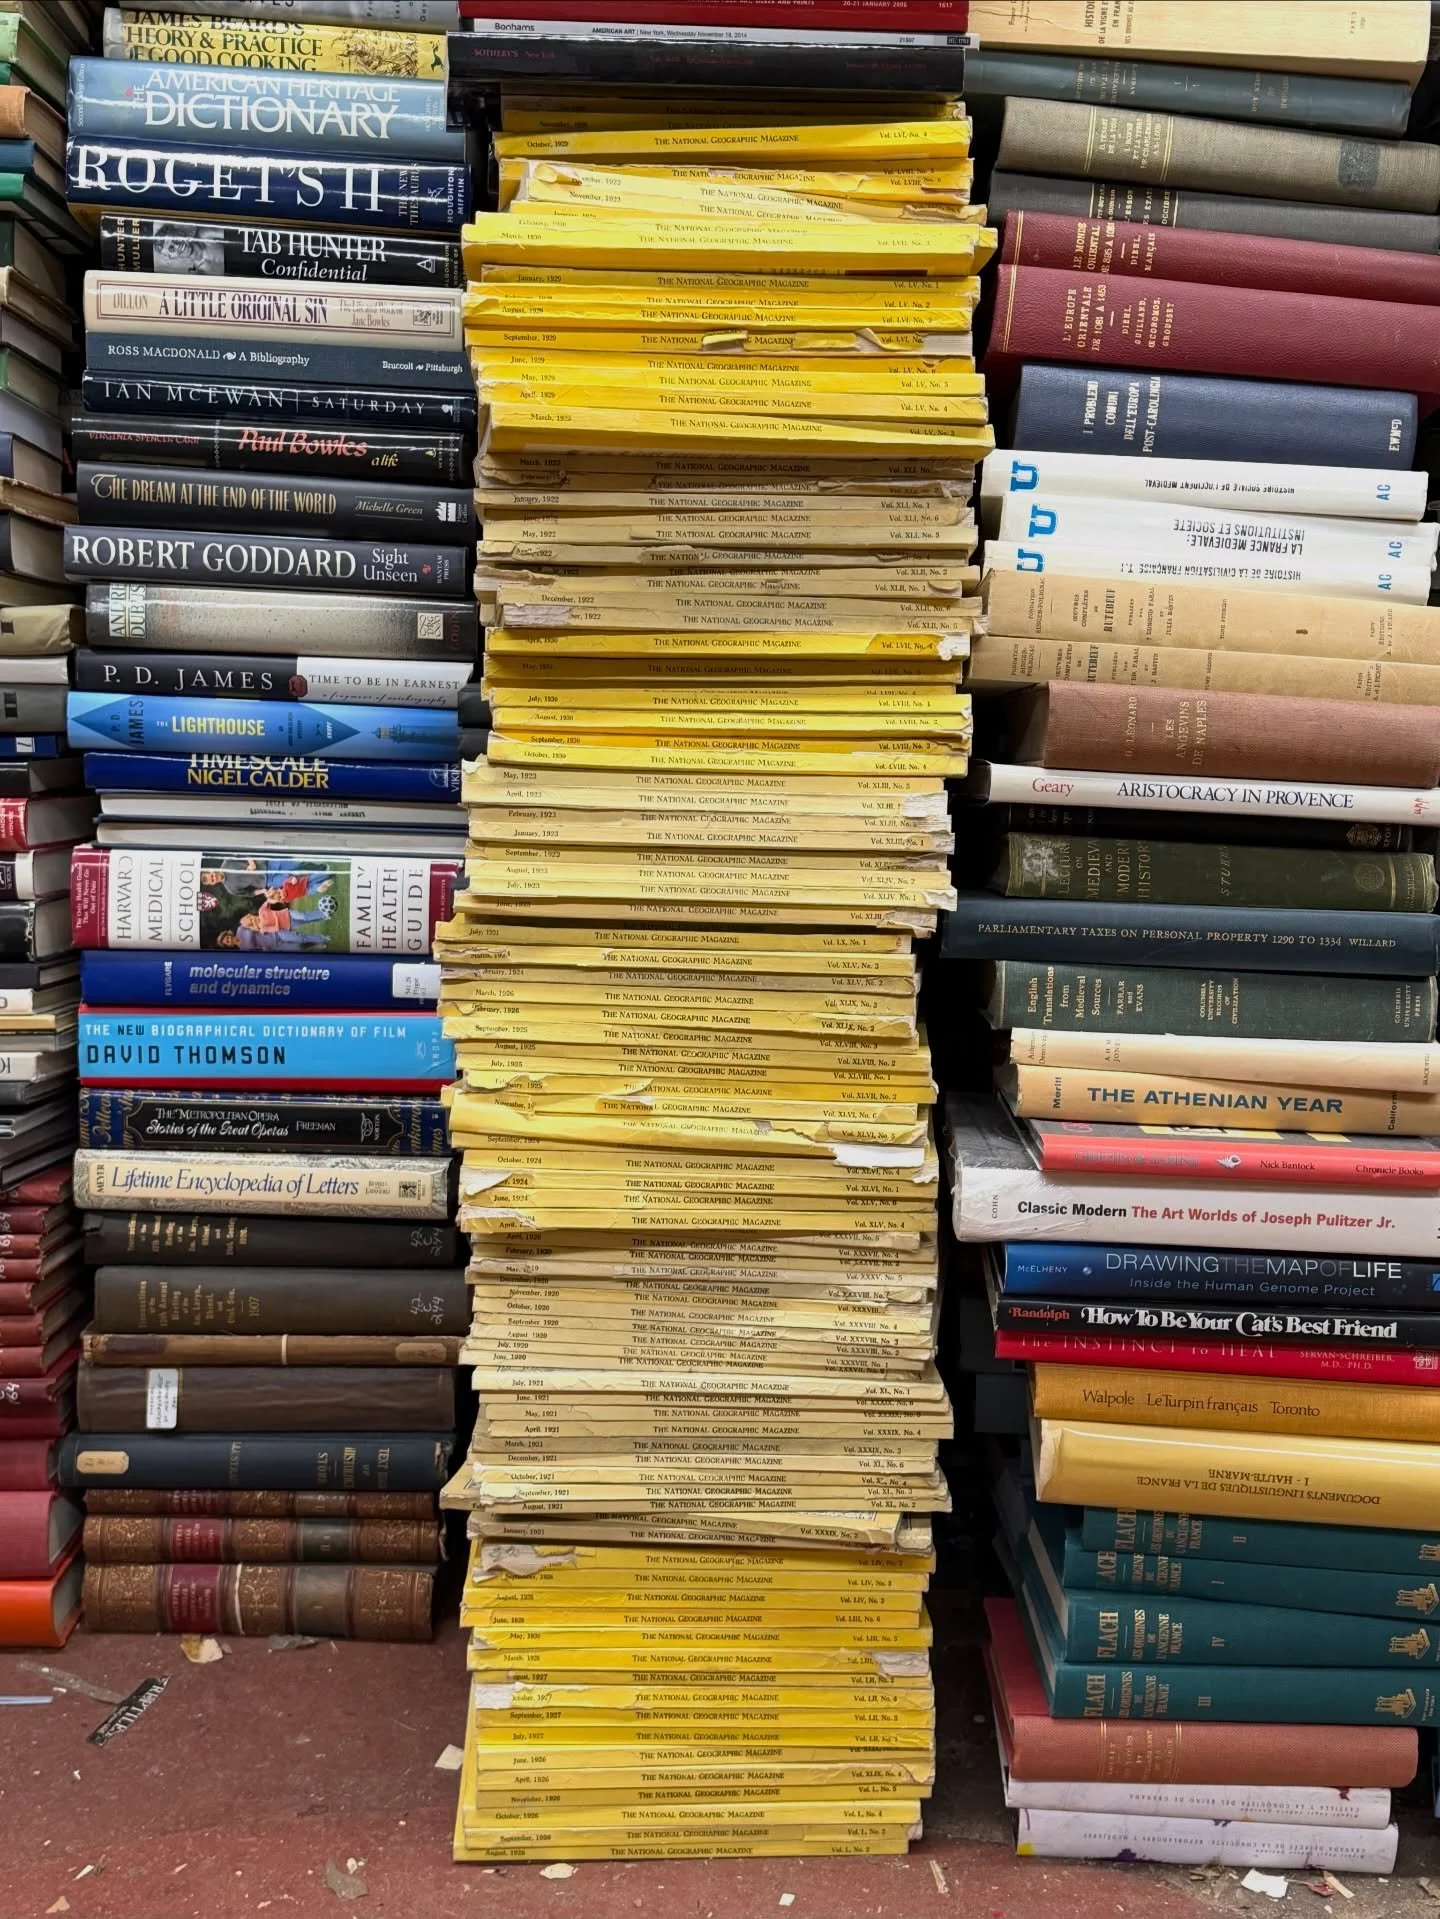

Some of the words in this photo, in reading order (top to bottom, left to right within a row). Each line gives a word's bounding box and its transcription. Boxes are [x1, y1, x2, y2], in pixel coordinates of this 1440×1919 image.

[495, 21, 535, 33] Bonhams
[146, 92, 399, 139] DICTIONARY
[69, 144, 325, 207] ROGET'S
[339, 168, 384, 212] II
[238, 229, 281, 254] TAB
[289, 233, 386, 262] HUNTER
[262, 259, 367, 281] Confidential
[108, 346, 139, 356] ROSS
[143, 346, 220, 360] MACDONALD
[250, 352, 309, 365] Bibliography
[383, 361, 413, 370] Bruccoli
[425, 363, 462, 373] Pittsburgh
[312, 396, 425, 415] SATURDAY
[1105, 391, 1119, 424] COMUNI
[91, 473, 127, 500] THE
[132, 477, 176, 503] DREAM
[181, 484, 195, 505] AT
[197, 485, 219, 506] THE
[224, 486, 247, 508] END
[252, 489, 267, 510] OF
[268, 489, 288, 511] THE
[293, 492, 336, 515] WORLD
[540, 530, 556, 538] 1922
[656, 531, 672, 539] THE
[674, 530, 713, 539] NATIONAL
[716, 531, 768, 539] GEOGRAPHIC
[770, 531, 811, 539] MAGAZINE
[72, 535, 195, 570] ROBERT
[203, 543, 356, 578] GODDARD
[372, 548, 409, 566] Sight
[1249, 540, 1287, 553] FRANCE
[1290, 543, 1302, 552] LA
[363, 563, 418, 583] Unseen
[104, 665, 120, 683] P.
[136, 666, 159, 685] D.
[174, 668, 273, 691] JAMES
[309, 674, 340, 685] TIME
[344, 675, 361, 686] TO
[366, 677, 382, 687] BE
[386, 678, 400, 687] IN
[404, 678, 460, 690] EARNEST
[172, 716, 265, 736] LIGHTHOUSE
[188, 769, 248, 786] NIGEL
[251, 770, 328, 789] CALDER
[1032, 777, 1073, 797] Geary
[1117, 782, 1237, 802] ARISTOCRACY
[1242, 787, 1261, 803] IN
[1266, 789, 1353, 808] PROVENCE
[144, 857, 164, 942] MEDICAL
[179, 859, 195, 943] SCHOOL
[357, 866, 373, 949] FAMILY
[382, 866, 398, 949] HEALTH
[407, 869, 423, 951] GUIDE
[978, 925, 1077, 936] PARLIAMENTARY
[1081, 927, 1117, 938] TAXES
[1121, 929, 1138, 938] ON
[1142, 930, 1201, 941] PERSONAL
[1207, 932, 1268, 943] PROPERTY
[1273, 935, 1295, 945] 1290
[1299, 935, 1316, 945] TO
[1320, 936, 1342, 946] 1334
[1349, 939, 1396, 947] WILLARD
[190, 965, 261, 980] molecular
[265, 966, 330, 980] structure
[190, 980, 217, 994] and
[222, 982, 290, 995] dynamics
[1028, 978, 1038, 1013] English
[1043, 967, 1053, 1025] Translations
[1060, 985, 1069, 1007] from
[1075, 976, 1085, 1018] Medieval
[1092, 978, 1102, 1015] Sources
[86, 1024, 110, 1035] THE
[117, 1025, 145, 1036] NEW
[151, 1025, 255, 1037] BIOGRAPHICAL
[263, 1026, 343, 1038] DICTIONARY
[351, 1027, 367, 1038] OF
[373, 1028, 406, 1038] FILM
[87, 1046, 160, 1064] DAVID
[176, 1046, 286, 1064] THOMSON
[1088, 1088, 1135, 1103] THE
[1144, 1091, 1268, 1109] ATHENIAN
[1277, 1096, 1343, 1113] YEAR
[1260, 1160, 1278, 1169] Nick
[1281, 1162, 1315, 1171] Bantock
[1399, 1167, 1424, 1176] Books
[97, 1164, 105, 1193] MEYER
[112, 1167, 171, 1189] Lifetime
[176, 1169, 283, 1196] Encyclopedia
[286, 1174, 304, 1197] of
[306, 1175, 359, 1195] Letters
[1018, 1201, 1067, 1215] Classic
[1072, 1203, 1127, 1218] Modern
[1131, 1205, 1157, 1219] The
[1162, 1207, 1184, 1219] Art
[1188, 1208, 1238, 1222] Worlds
[1242, 1210, 1257, 1222] of
[1260, 1212, 1311, 1227] Joseph
[1316, 1215, 1372, 1228] Pulitzer
[1377, 1217, 1395, 1229] Jr.
[1130, 1278, 1172, 1290] Inside
[1178, 1279, 1199, 1290] the
[1205, 1280, 1254, 1291] Human
[1260, 1282, 1319, 1294] Genome
[1324, 1283, 1375, 1298] Project
[1081, 1308, 1133, 1327] How
[1136, 1309, 1158, 1326] To
[1160, 1311, 1188, 1328] Be
[1188, 1312, 1232, 1332] Your
[1236, 1312, 1282, 1337] Cat's
[1286, 1317, 1332, 1336] Best
[1333, 1319, 1397, 1338] Friend
[1083, 1390, 1135, 1405] Walpole
[1207, 1398, 1258, 1413] français
[1270, 1401, 1320, 1416] Toronto
[654, 1425, 670, 1434] THE
[670, 1426, 708, 1435] NATIONAL
[712, 1426, 761, 1435] GEOGRAPHIC
[762, 1426, 800, 1435] MAGAZINE
[1136, 1476, 1180, 1488] FRANCE
[1307, 1489, 1380, 1504] DOCUMENTS
[1097, 1611, 1119, 1658] FLACH
[622, 1810, 638, 1819] THE
[640, 1810, 676, 1819] NATIONAL
[680, 1810, 726, 1819] GEOGRAPHIC
[729, 1810, 765, 1819] MAGAZINE
